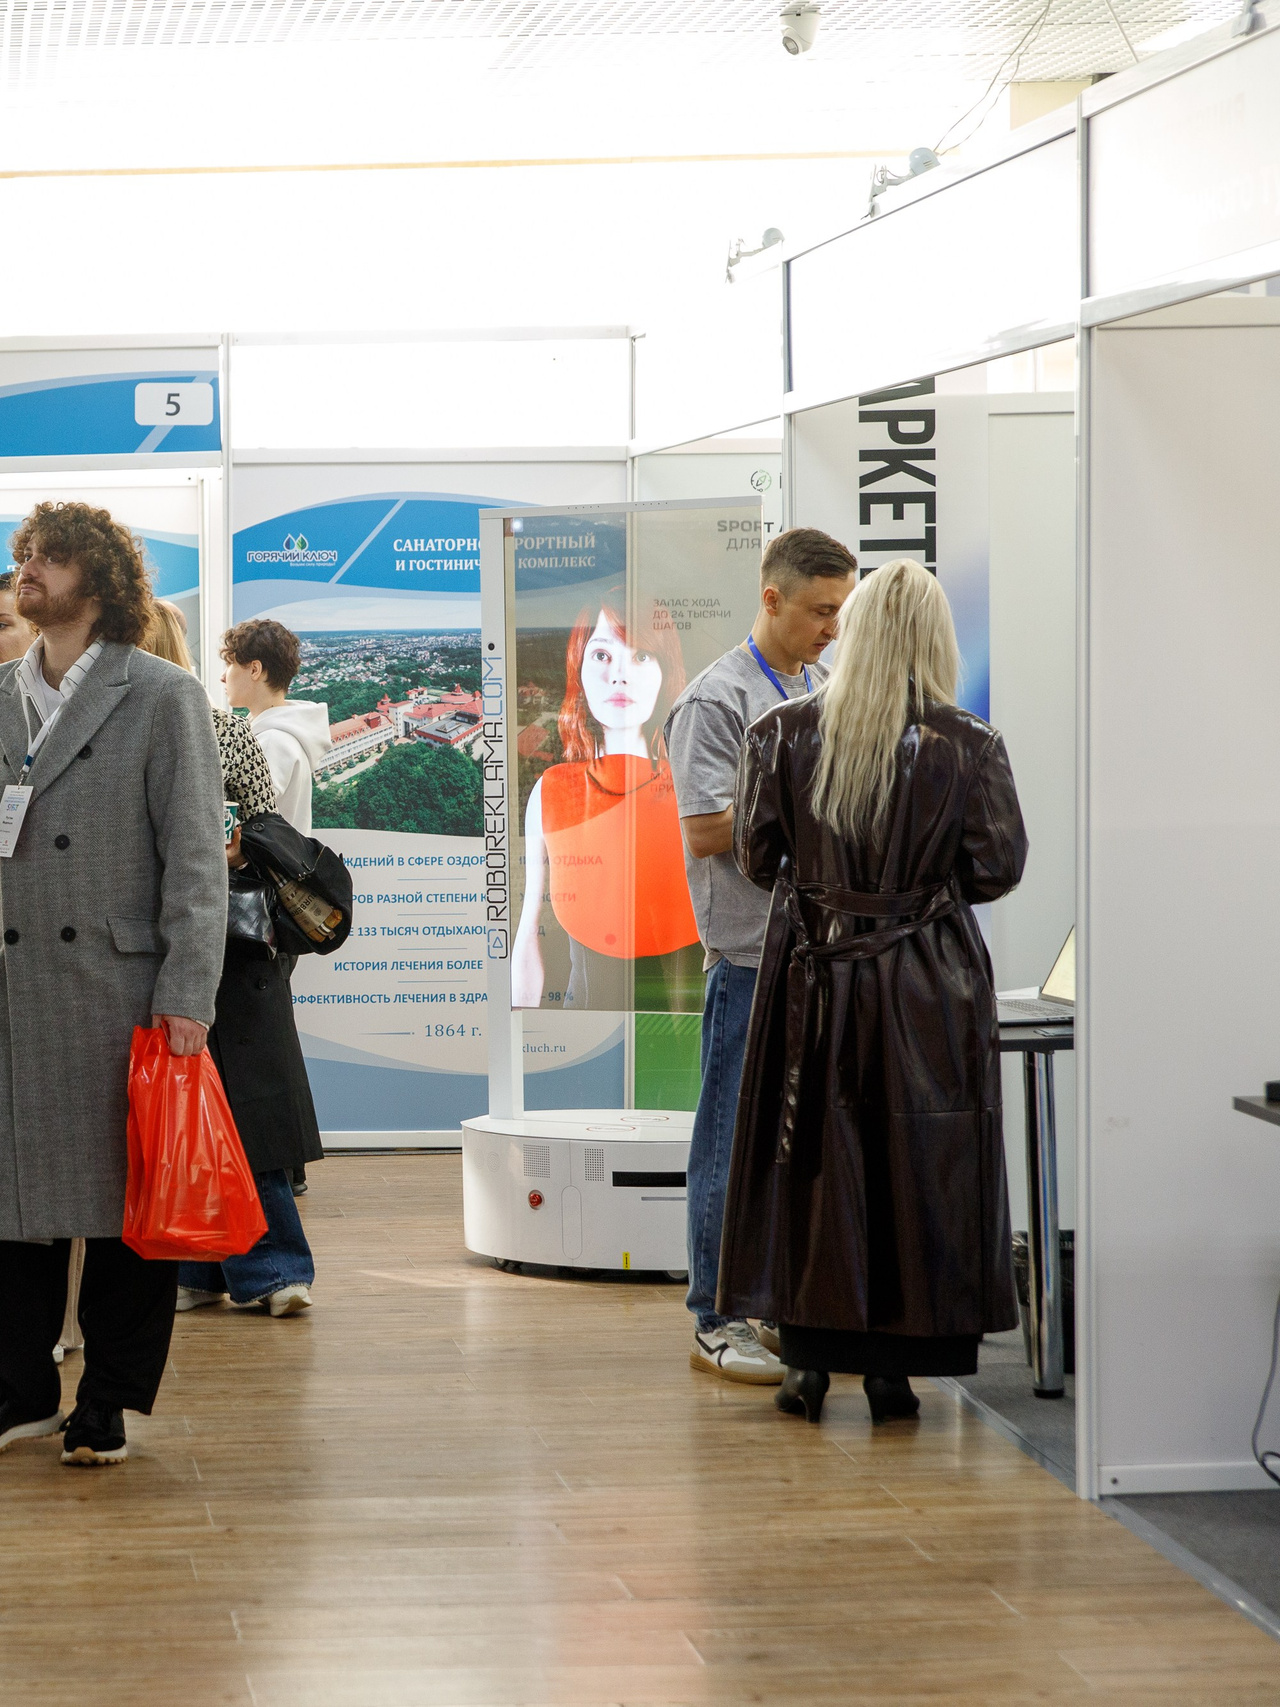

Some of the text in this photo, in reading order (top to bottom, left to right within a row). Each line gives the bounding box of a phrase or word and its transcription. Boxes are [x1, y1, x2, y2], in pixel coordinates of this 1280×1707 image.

[165, 392, 181, 416] 5
[393, 538, 481, 552] САНАТОРН
[247, 549, 337, 561] ГОРЯЧИЙ КЛЮЧ
[395, 560, 406, 571] И
[518, 556, 596, 569] КОМПЛЕКС
[653, 598, 721, 608] ЗАПАС ХОДА
[653, 610, 732, 619] ДО 24 ТЫСЯЧИ
[482, 657, 508, 921] ROBOREKLAMA.COM
[398, 857, 405, 866] В
[408, 856, 444, 867] СФЕРЕ
[377, 891, 423, 904] РАЗНОЙ
[426, 893, 478, 903] СТЕПЕНИ
[358, 927, 377, 936] 133
[380, 926, 419, 937] ТЫСЯЧ
[334, 960, 484, 972] ИСТОРИЯ ЛЕЧЕНИЯ БОЛЕЕ
[291, 994, 391, 1005] ЭФФЕКТИВНОСТЬ
[393, 993, 446, 1004] ЛЕЧЕНИЯ
[449, 993, 456, 1003] В
[548, 991, 562, 1002] 98
[425, 1024, 482, 1037] 1864 г.
